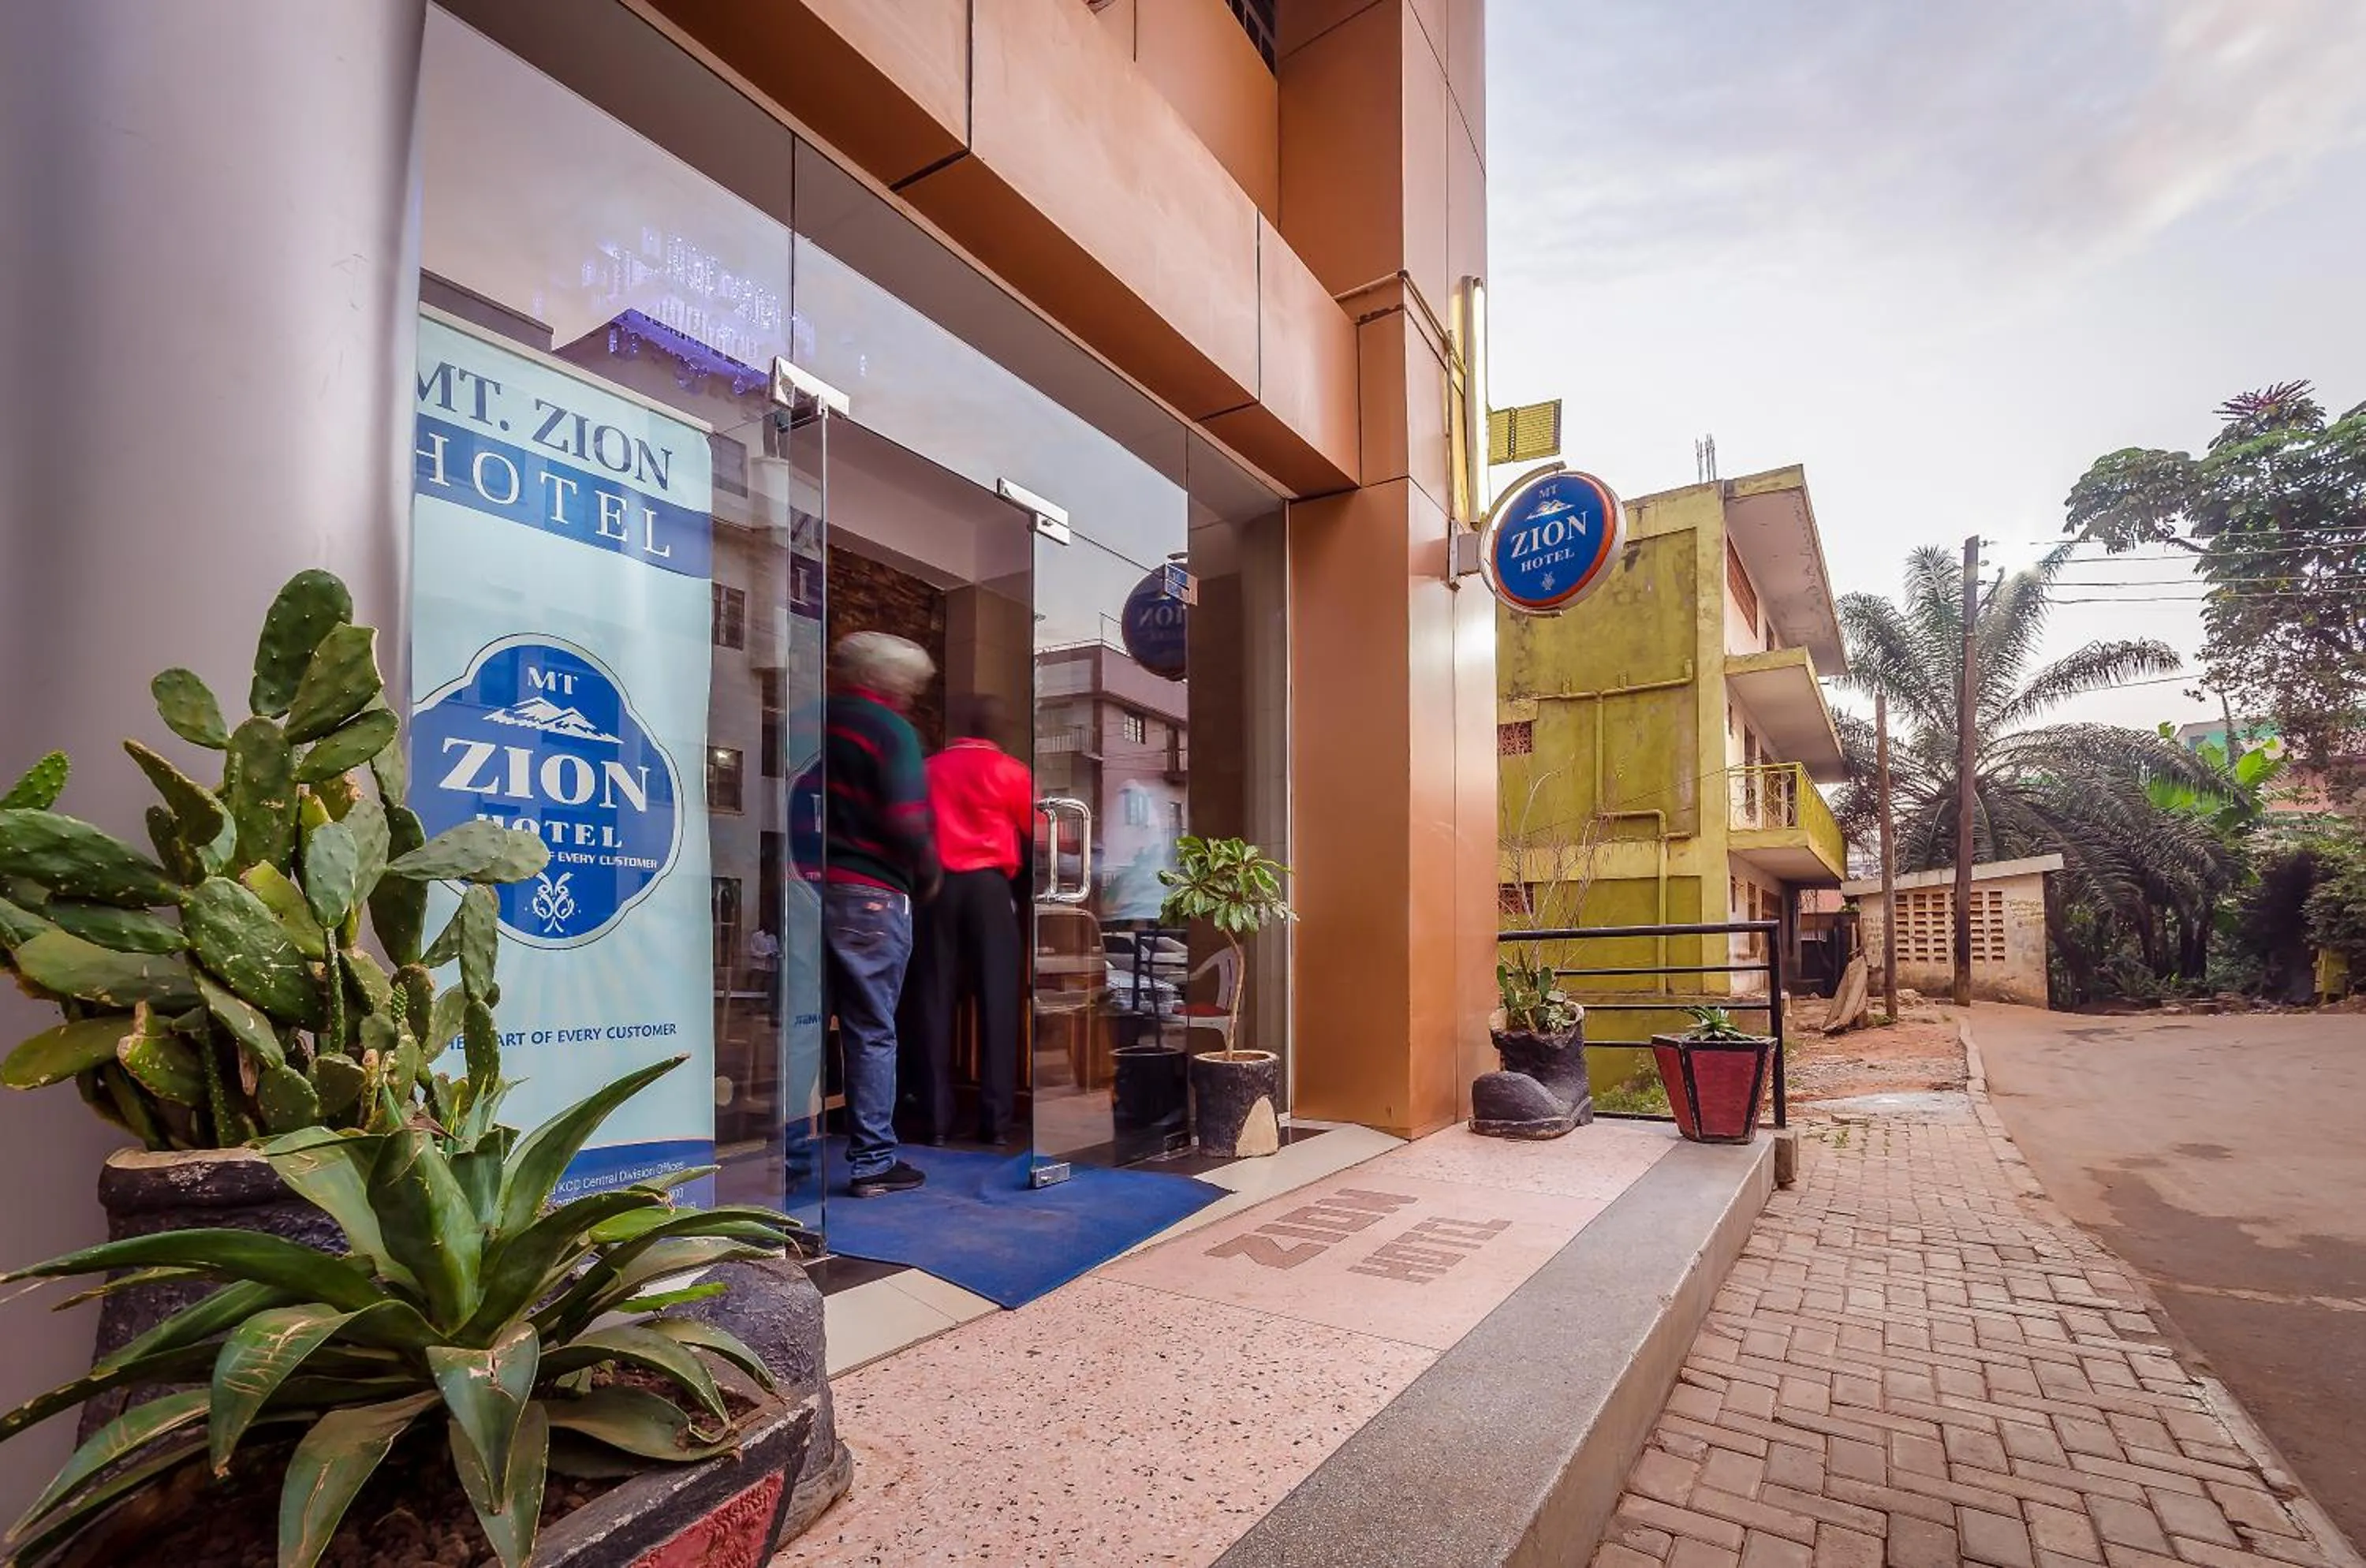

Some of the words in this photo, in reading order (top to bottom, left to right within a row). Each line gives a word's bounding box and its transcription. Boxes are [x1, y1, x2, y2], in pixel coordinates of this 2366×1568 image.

[417, 362, 509, 431] MT.
[532, 398, 673, 491] ZION
[1539, 484, 1558, 498] MT
[1510, 511, 1588, 558] ZION
[1521, 548, 1575, 573] HOTEL
[528, 667, 580, 695] MT
[439, 737, 651, 812] ZION
[558, 851, 597, 864] EVERY
[599, 855, 658, 868] CUSTOMER
[531, 1030, 554, 1045] OF
[558, 1028, 602, 1043] EVERY
[606, 1023, 677, 1040] CUSTOMER
[584, 1170, 618, 1189] Central
[619, 1167, 655, 1182] Division
[1346, 1216, 1513, 1285] HOTEL
